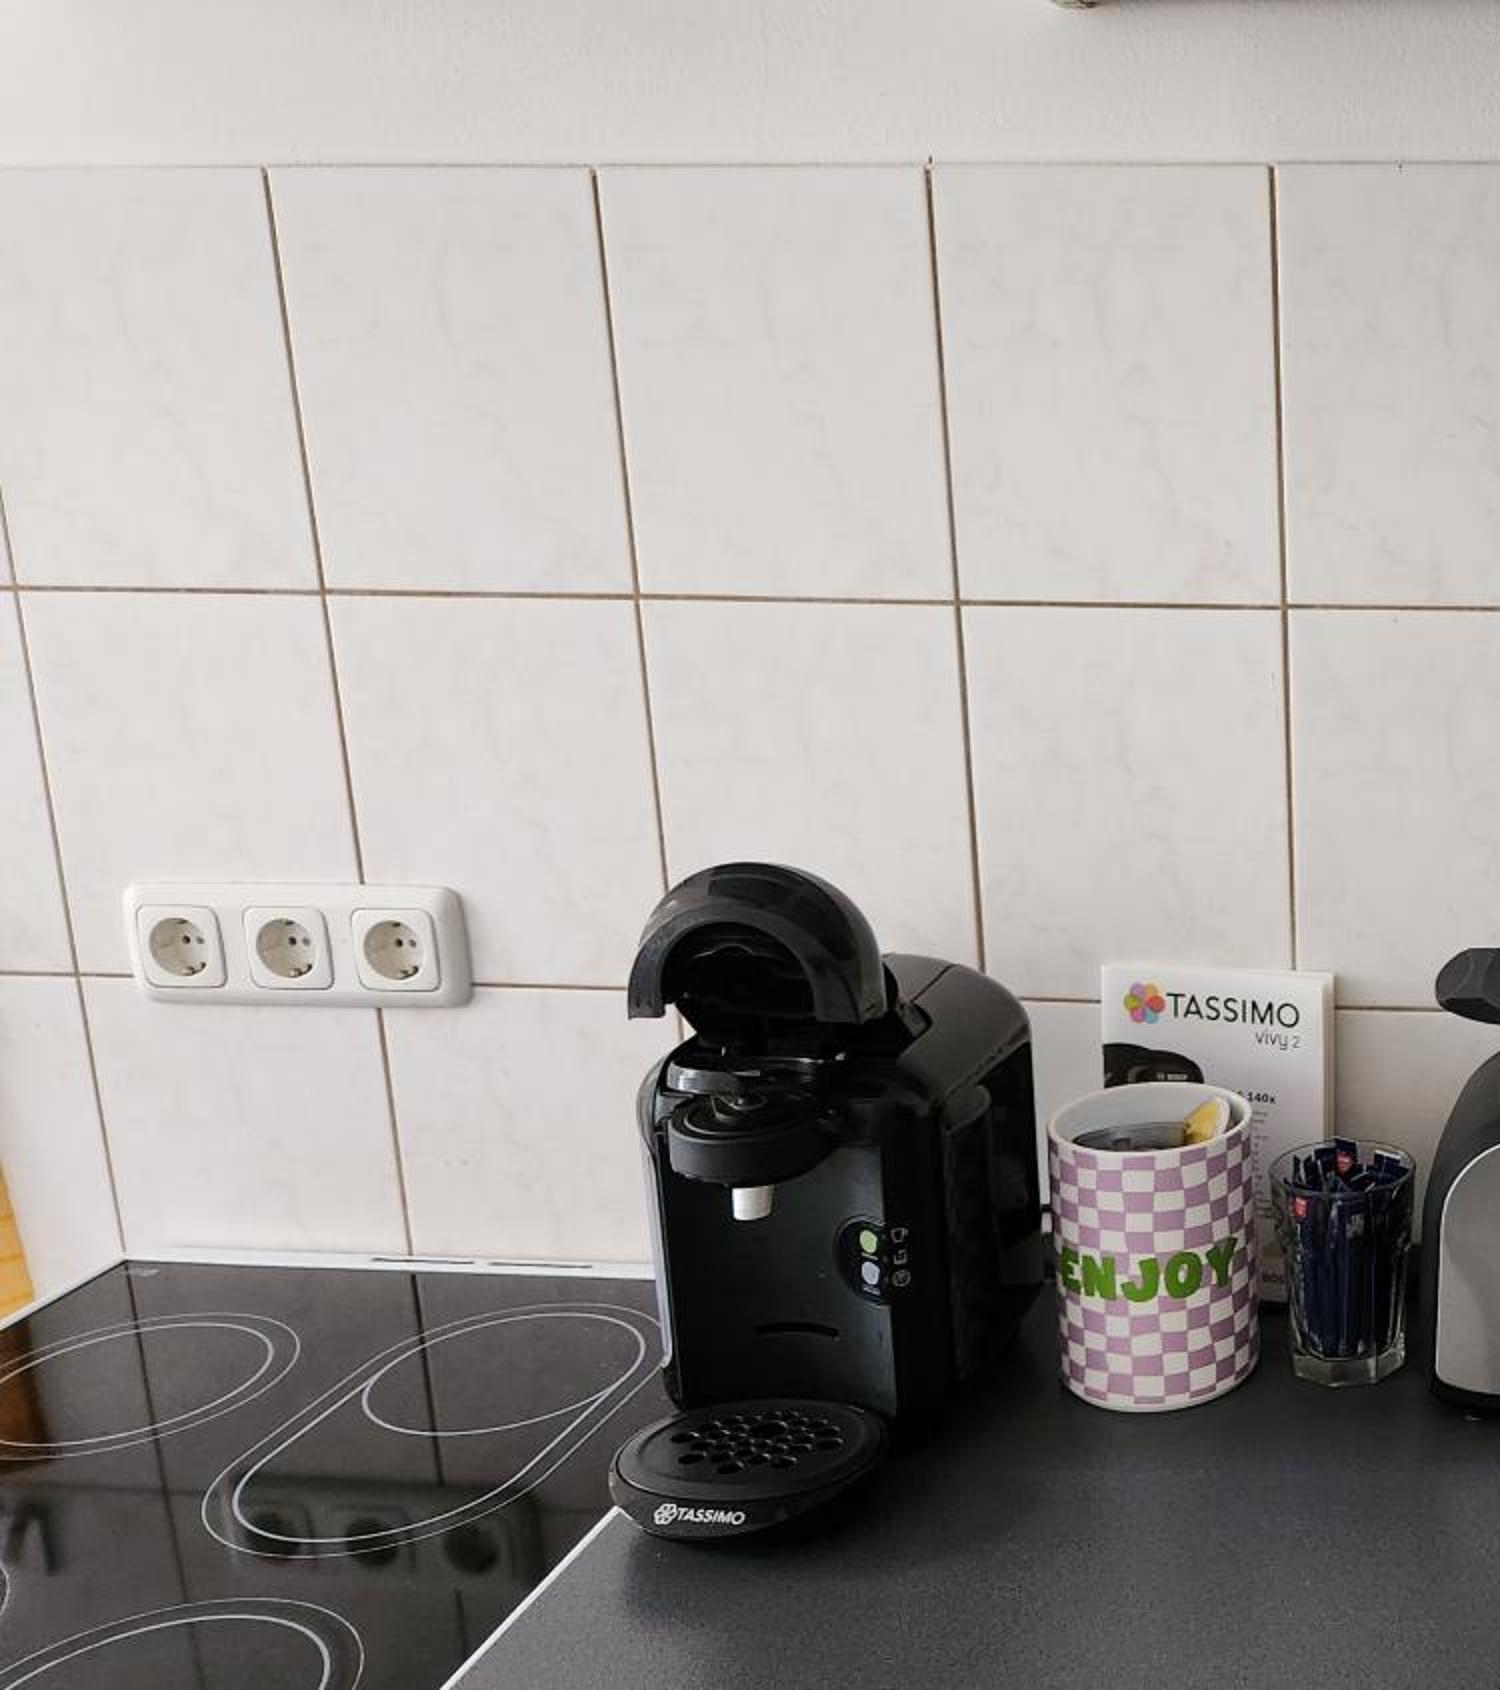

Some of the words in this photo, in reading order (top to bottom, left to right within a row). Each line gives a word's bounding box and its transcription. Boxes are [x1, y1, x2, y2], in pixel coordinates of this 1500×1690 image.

[1166, 992, 1300, 1028] TASSIMO
[1255, 1031, 1287, 1050] vivy
[1061, 1236, 1238, 1303] ENJOY
[677, 1507, 746, 1525] TASSIMO
